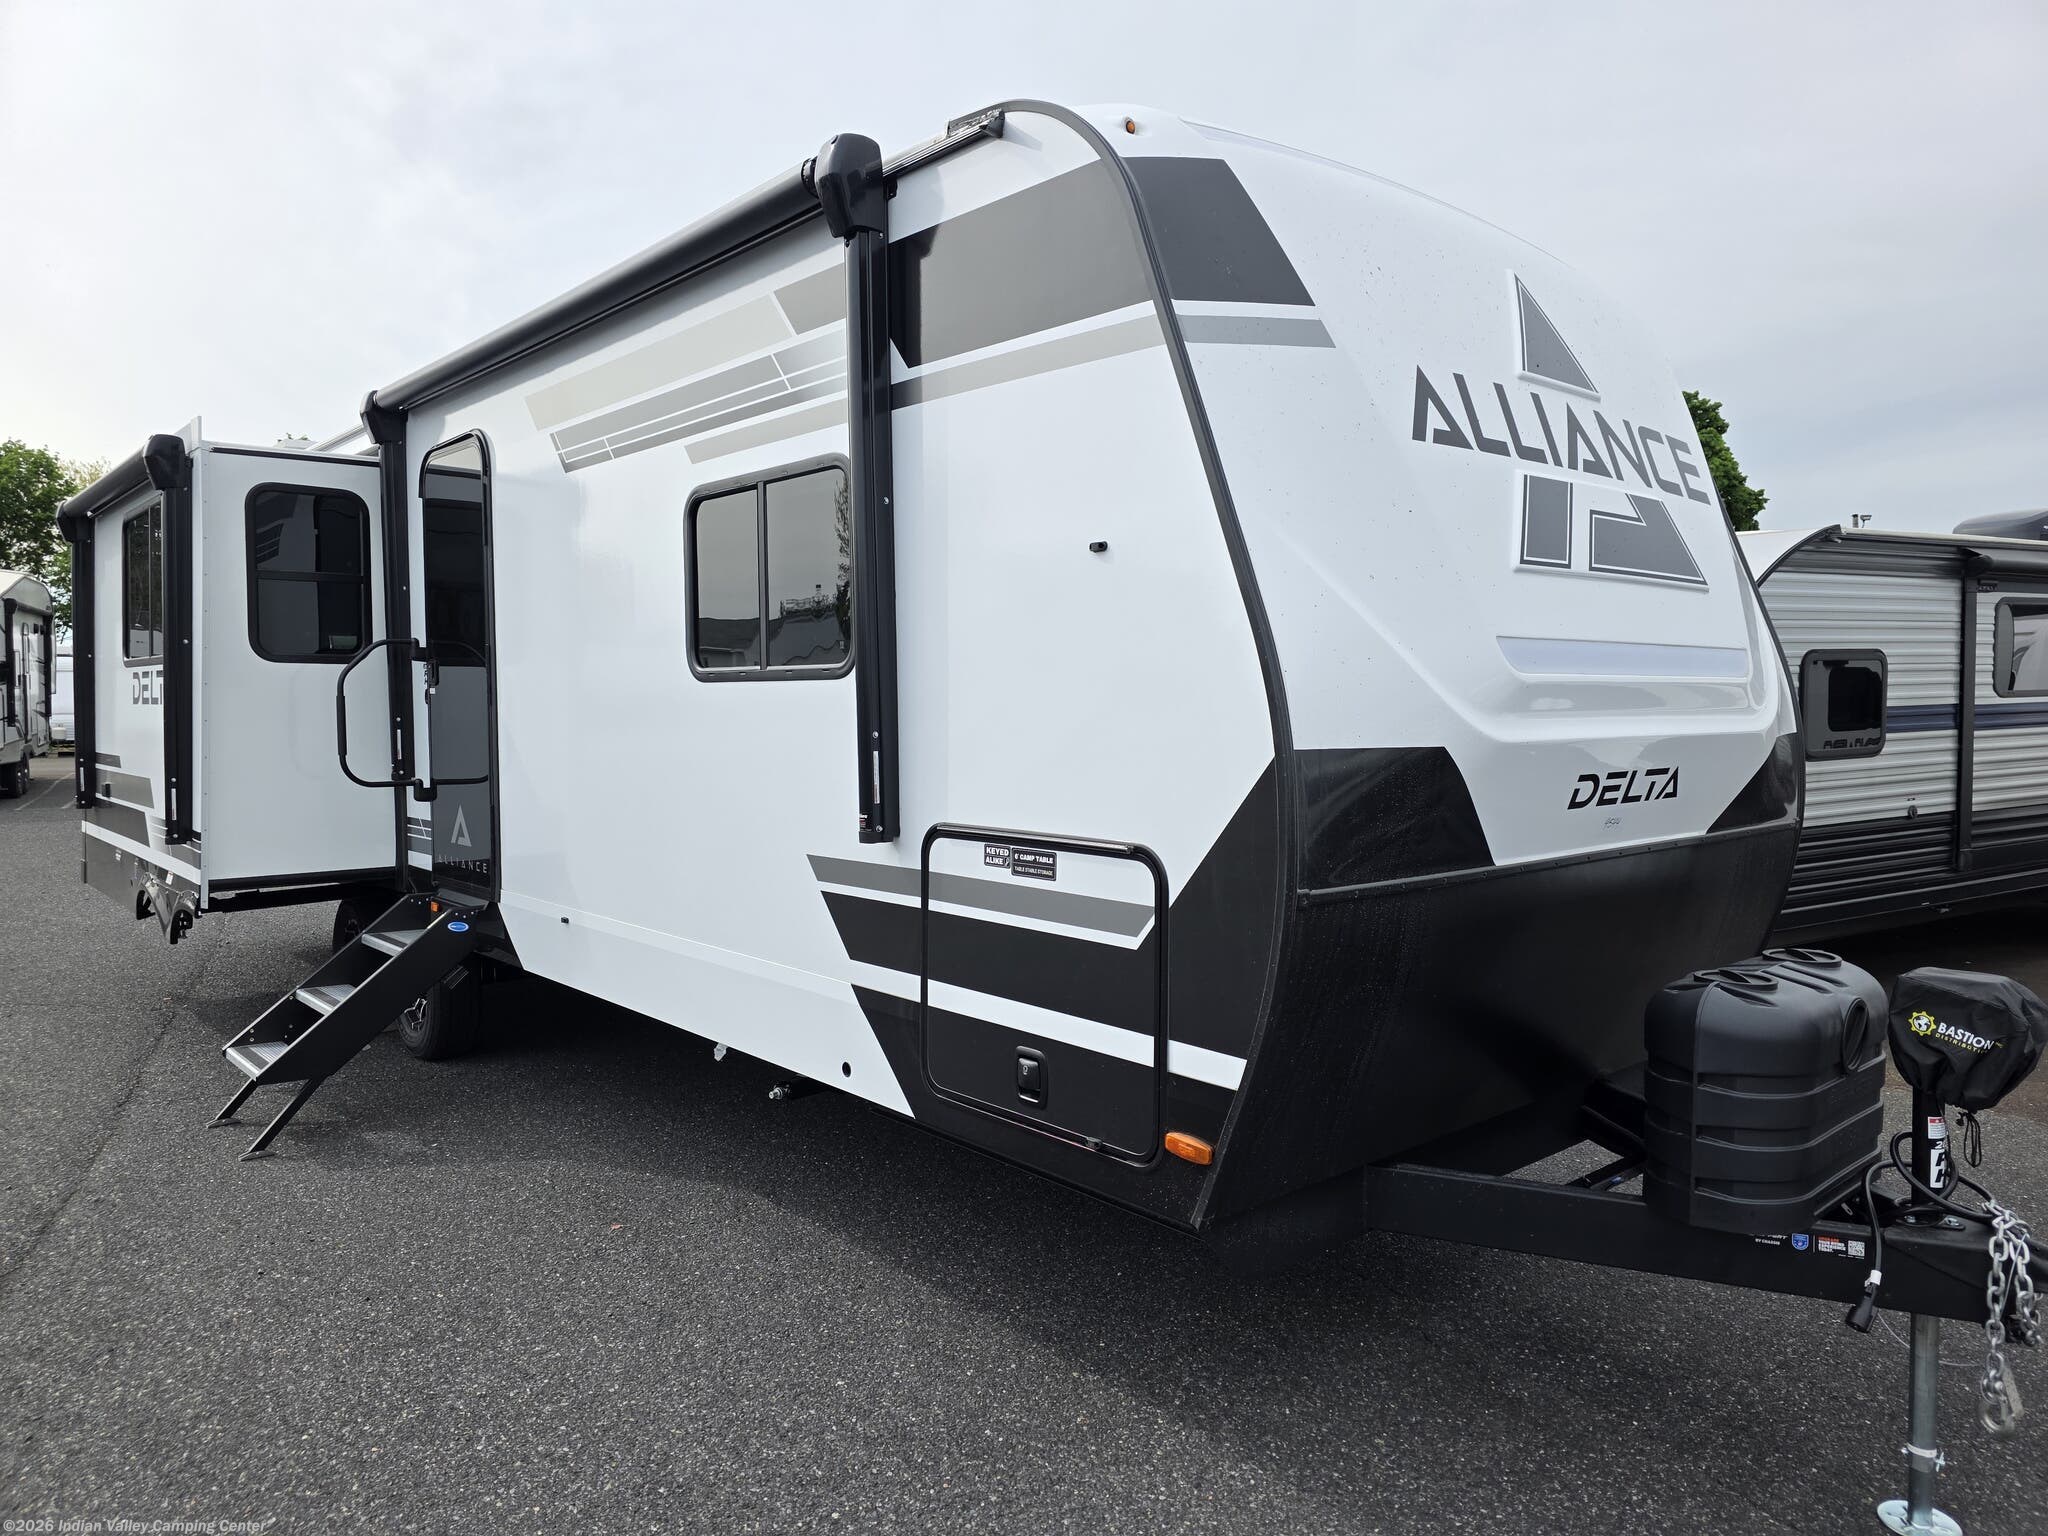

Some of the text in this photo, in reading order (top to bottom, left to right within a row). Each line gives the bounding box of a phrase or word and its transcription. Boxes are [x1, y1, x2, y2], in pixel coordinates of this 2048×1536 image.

[1412, 364, 1711, 506] ALLIANCE
[132, 670, 164, 705] DELT
[1567, 766, 1679, 810] DELTA
[985, 856, 1004, 865] ALIKE
[986, 846, 1009, 857] KEYED
[1020, 853, 1035, 862] CAMP
[1035, 855, 1054, 864] TABLE
[438, 854, 488, 874] ALLIANCE
[1937, 1022, 1995, 1050] BASTION
